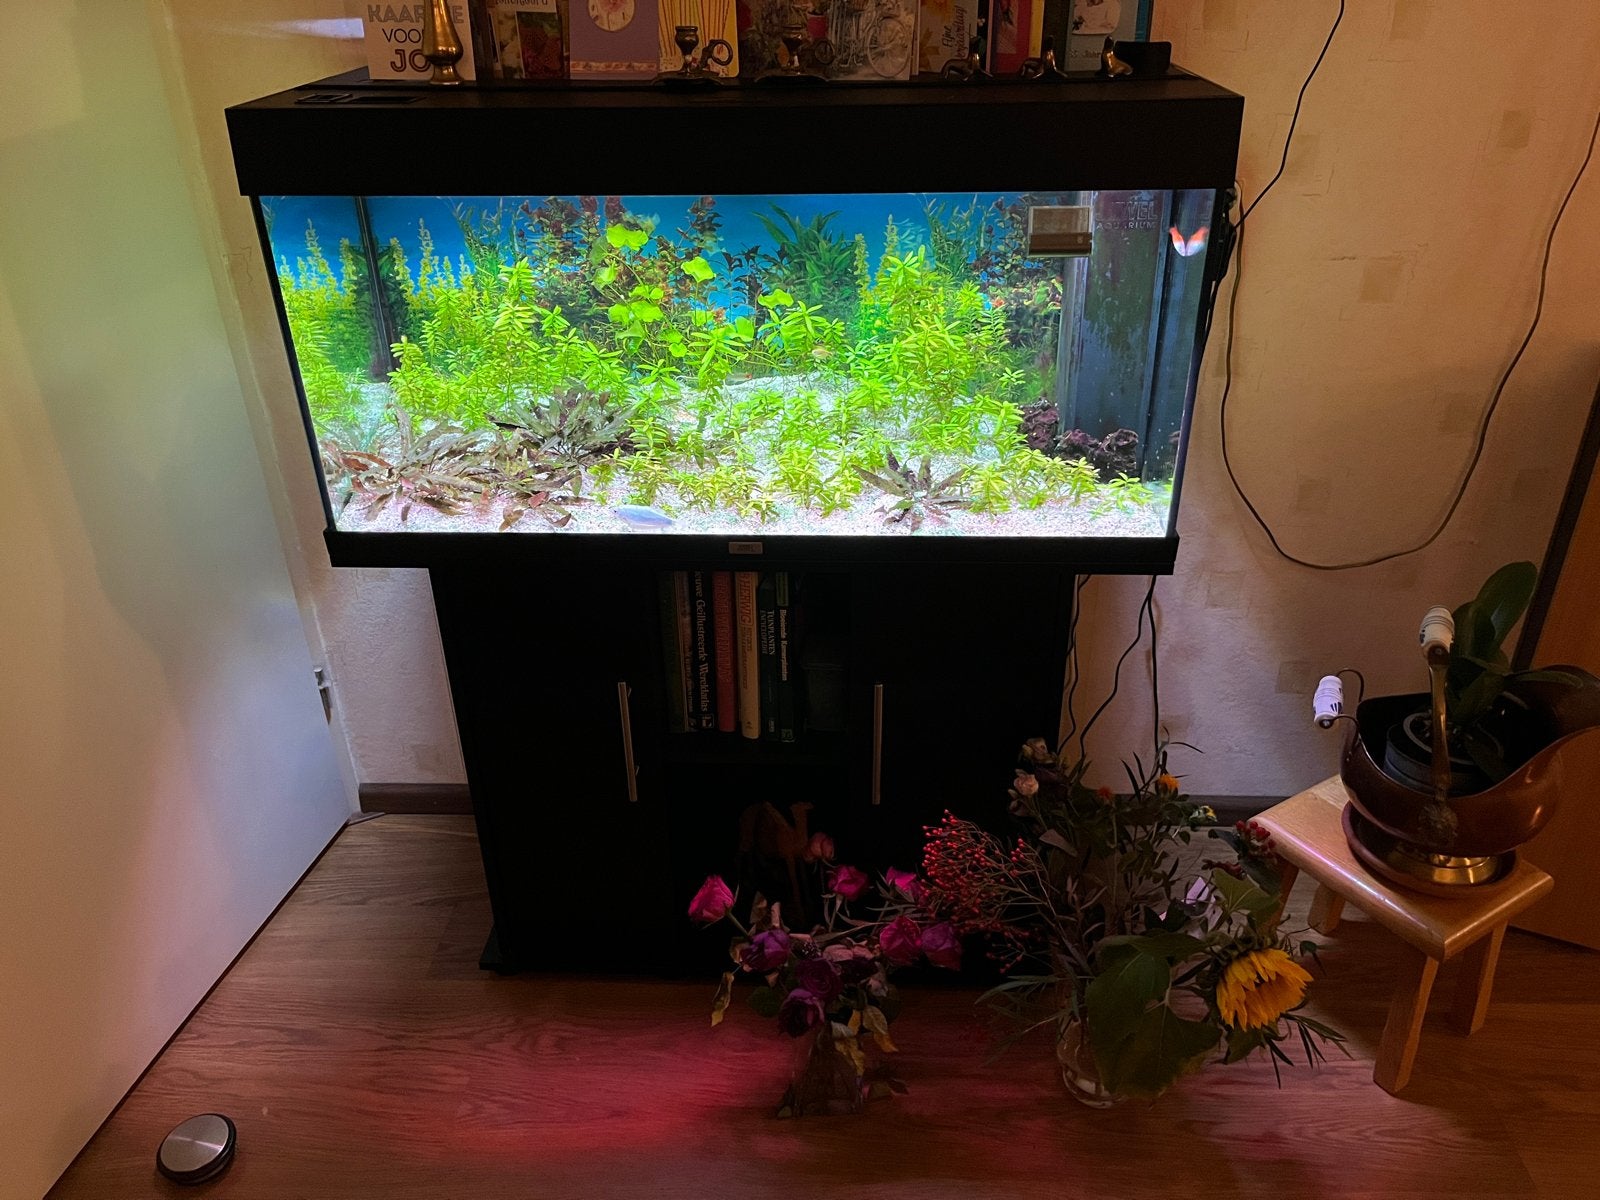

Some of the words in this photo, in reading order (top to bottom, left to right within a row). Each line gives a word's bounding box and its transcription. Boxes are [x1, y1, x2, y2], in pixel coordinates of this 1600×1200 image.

[367, 4, 464, 23] KAARE
[382, 28, 424, 43] VOO
[767, 610, 776, 655] TUINPLANTEN
[699, 662, 710, 712] Wereldatlas
